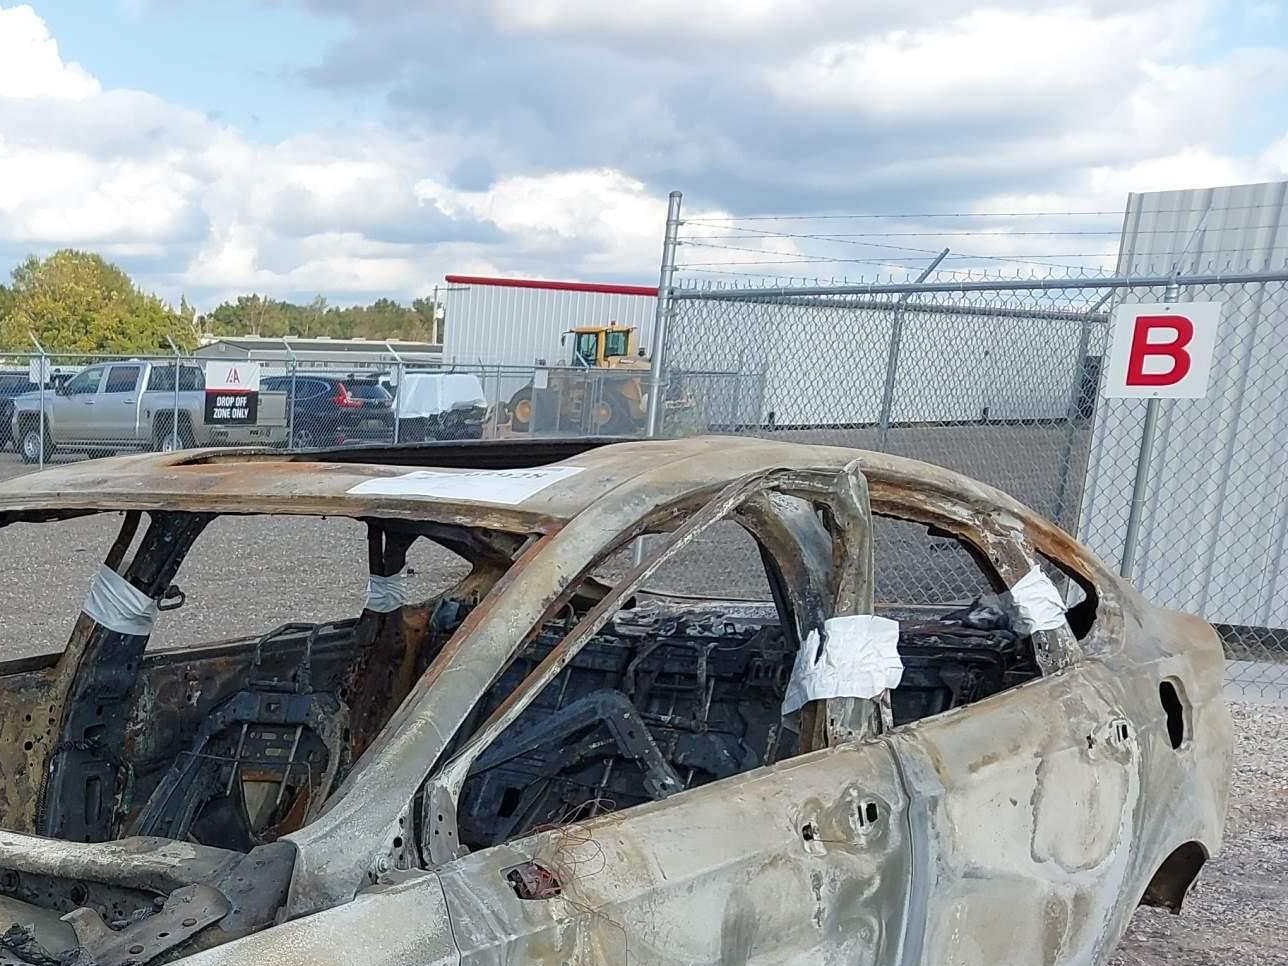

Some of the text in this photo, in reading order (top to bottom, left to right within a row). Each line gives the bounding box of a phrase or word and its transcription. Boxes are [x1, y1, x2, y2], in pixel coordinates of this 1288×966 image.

[1125, 315, 1194, 387] B
[216, 396, 247, 406] DROP OFF
[213, 408, 249, 419] ZONE ONLY
